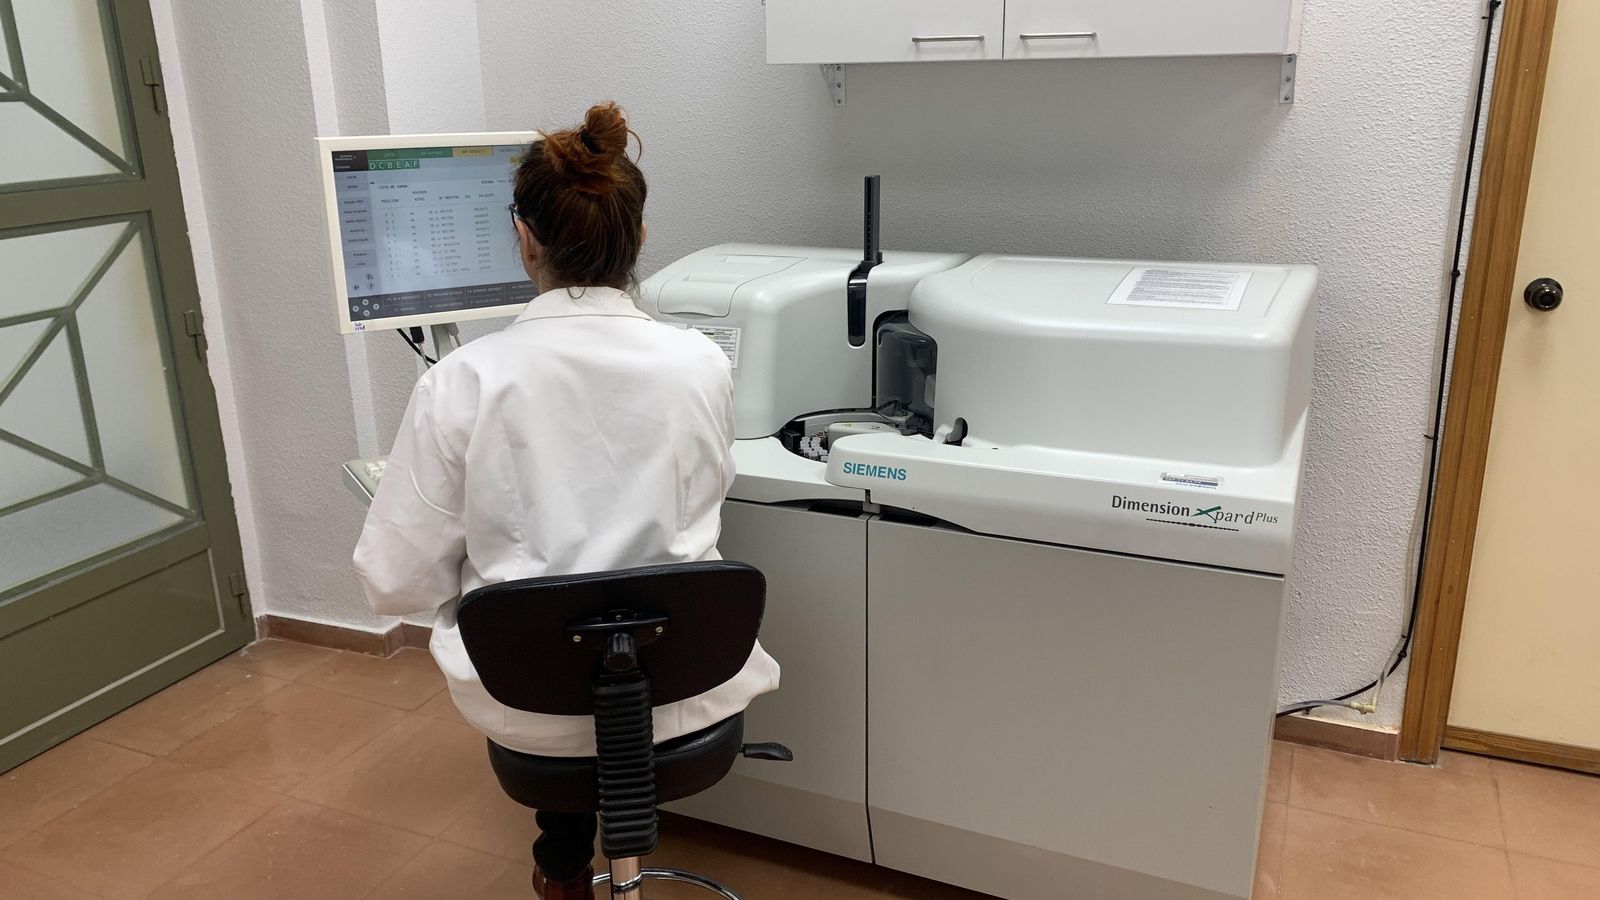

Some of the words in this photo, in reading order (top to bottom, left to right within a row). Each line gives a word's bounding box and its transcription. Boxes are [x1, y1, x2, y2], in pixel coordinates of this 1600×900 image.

[843, 462, 907, 481] SIEMENS
[1112, 495, 1190, 517] Dimension
[1255, 512, 1279, 524] Plus
